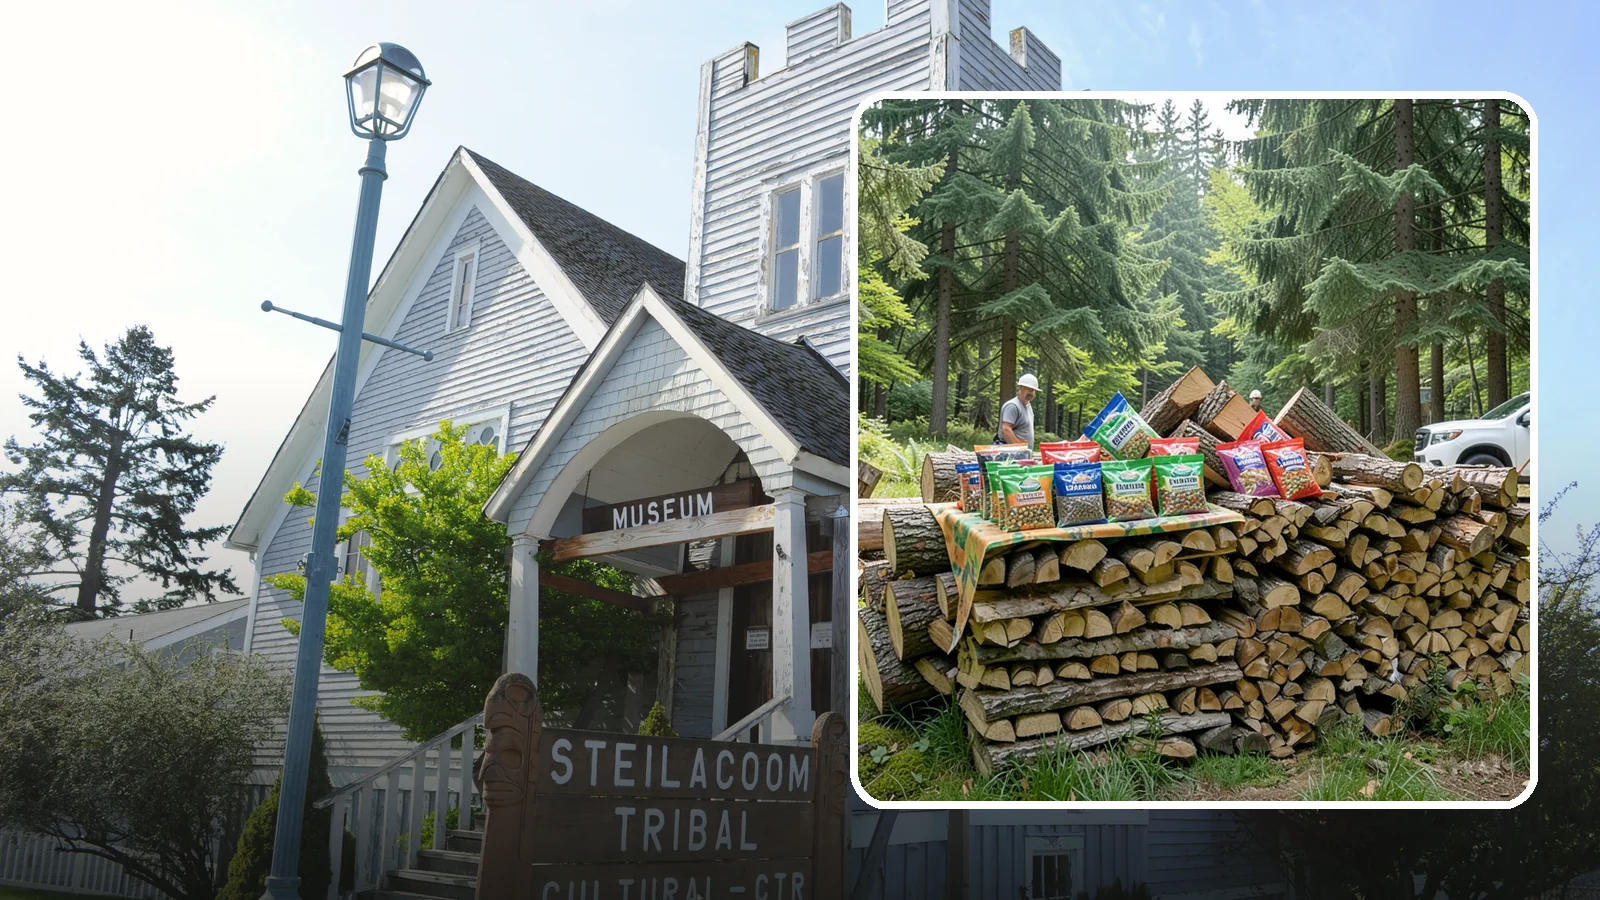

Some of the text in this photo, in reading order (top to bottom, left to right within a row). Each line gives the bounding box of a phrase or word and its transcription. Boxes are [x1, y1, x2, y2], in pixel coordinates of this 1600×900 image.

[612, 491, 713, 531] MUSEUM
[550, 738, 810, 792] STEILACOOM
[615, 807, 757, 852] TRIBAL
